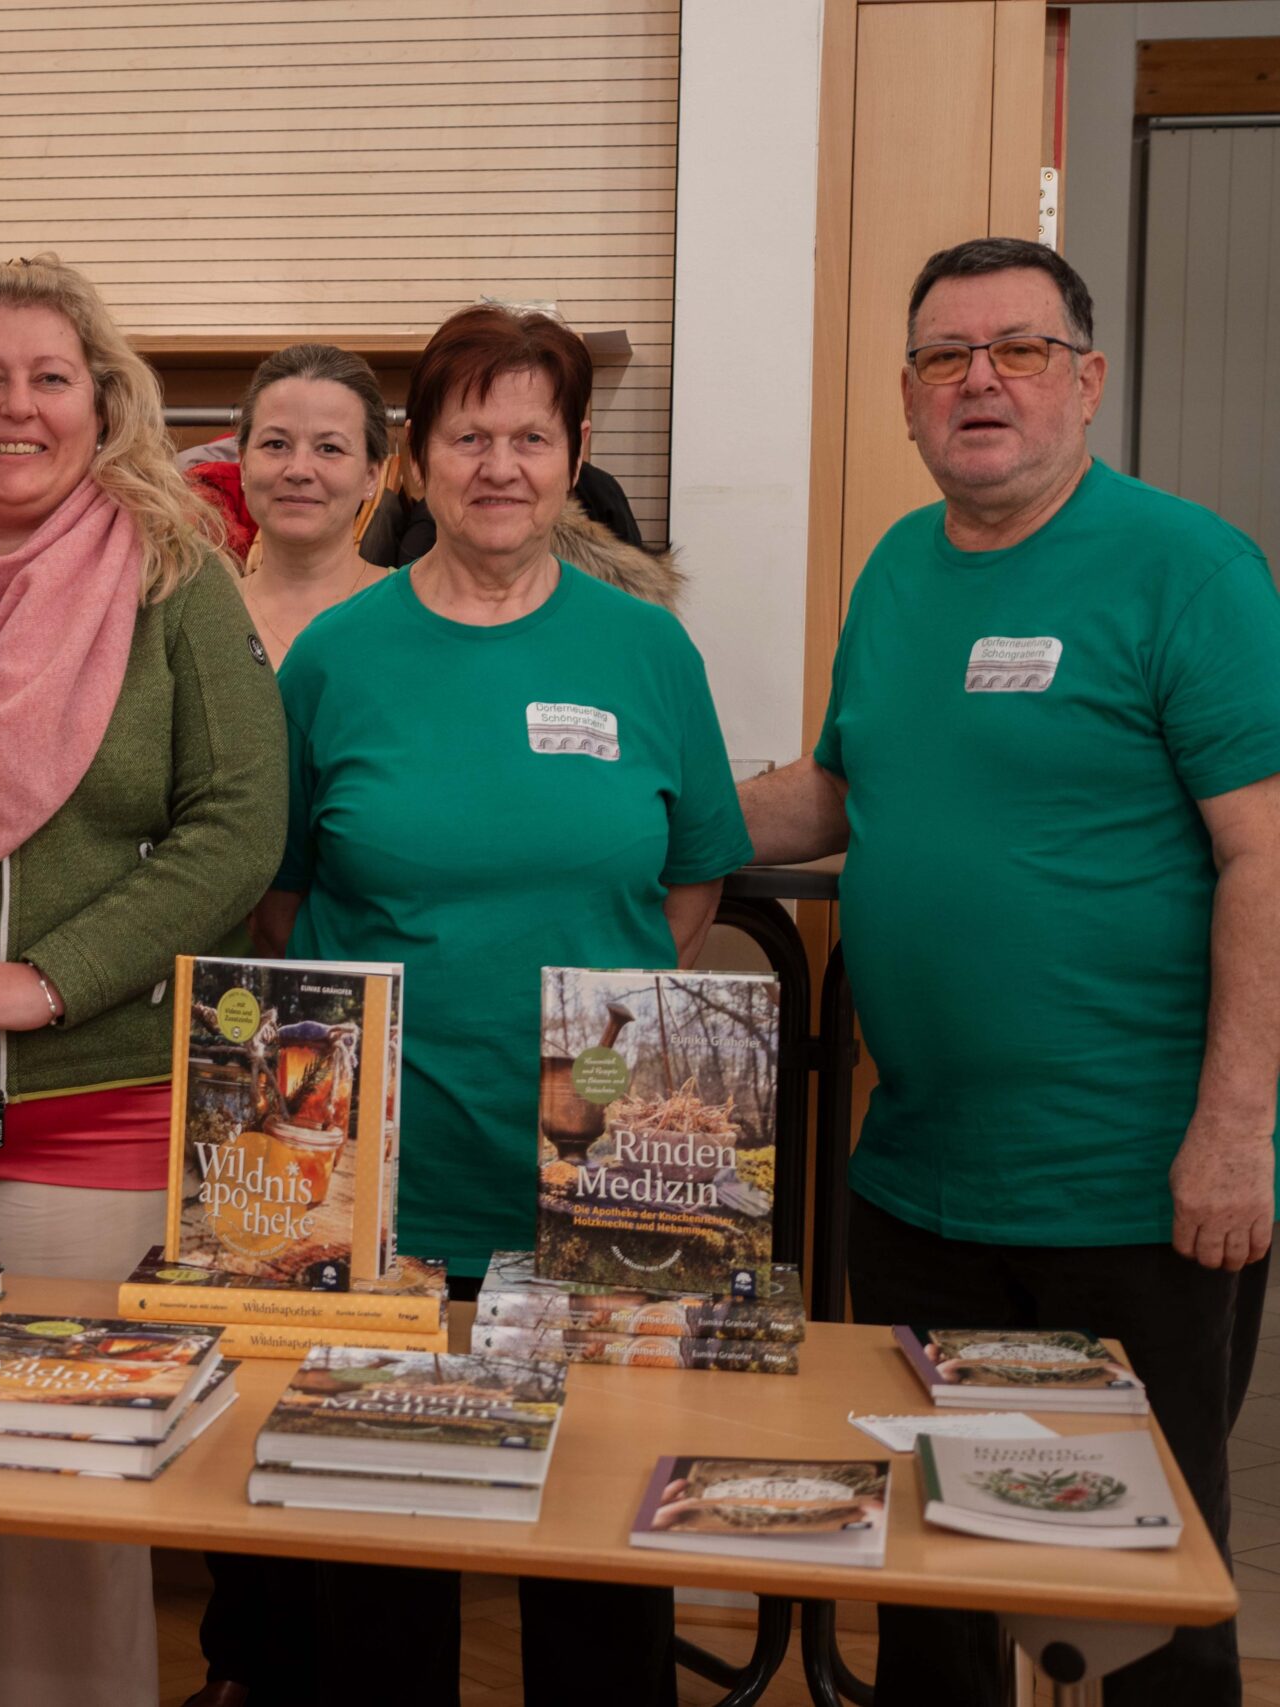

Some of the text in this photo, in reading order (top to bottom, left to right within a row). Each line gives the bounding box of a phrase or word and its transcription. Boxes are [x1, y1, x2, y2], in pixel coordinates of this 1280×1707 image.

[981, 638, 1053, 648] Dorferneuerung
[981, 649, 1045, 660] Schöngrabern
[536, 703, 608, 721] Dorferneuerung
[541, 713, 605, 729] Schöngrabern
[322, 986, 353, 996] GRAHOFER
[671, 1034, 761, 1049] Eunike Grahofer
[615, 1129, 737, 1170] Rinden
[193, 1138, 313, 1205] Wildnis
[575, 1166, 719, 1207] Medizin
[199, 1181, 248, 1216] apo
[243, 1203, 315, 1240] theke
[573, 1204, 735, 1226] Die Apotheke der Knochenrichter,
[573, 1216, 713, 1236] Holzknechte und Hebammen
[242, 1300, 323, 1317] Wildnisapotheke
[398, 1312, 419, 1321] freya
[610, 1312, 685, 1325] Rindenmedizin
[698, 1318, 758, 1328] Eunike Grahofer
[770, 1322, 794, 1331] freya
[605, 1343, 680, 1356] Rindenmedizin
[691, 1349, 752, 1360] Eunike Grahofer
[763, 1353, 787, 1363] freya
[370, 1389, 514, 1409] Rinden
[321, 1396, 490, 1419] Medizin
